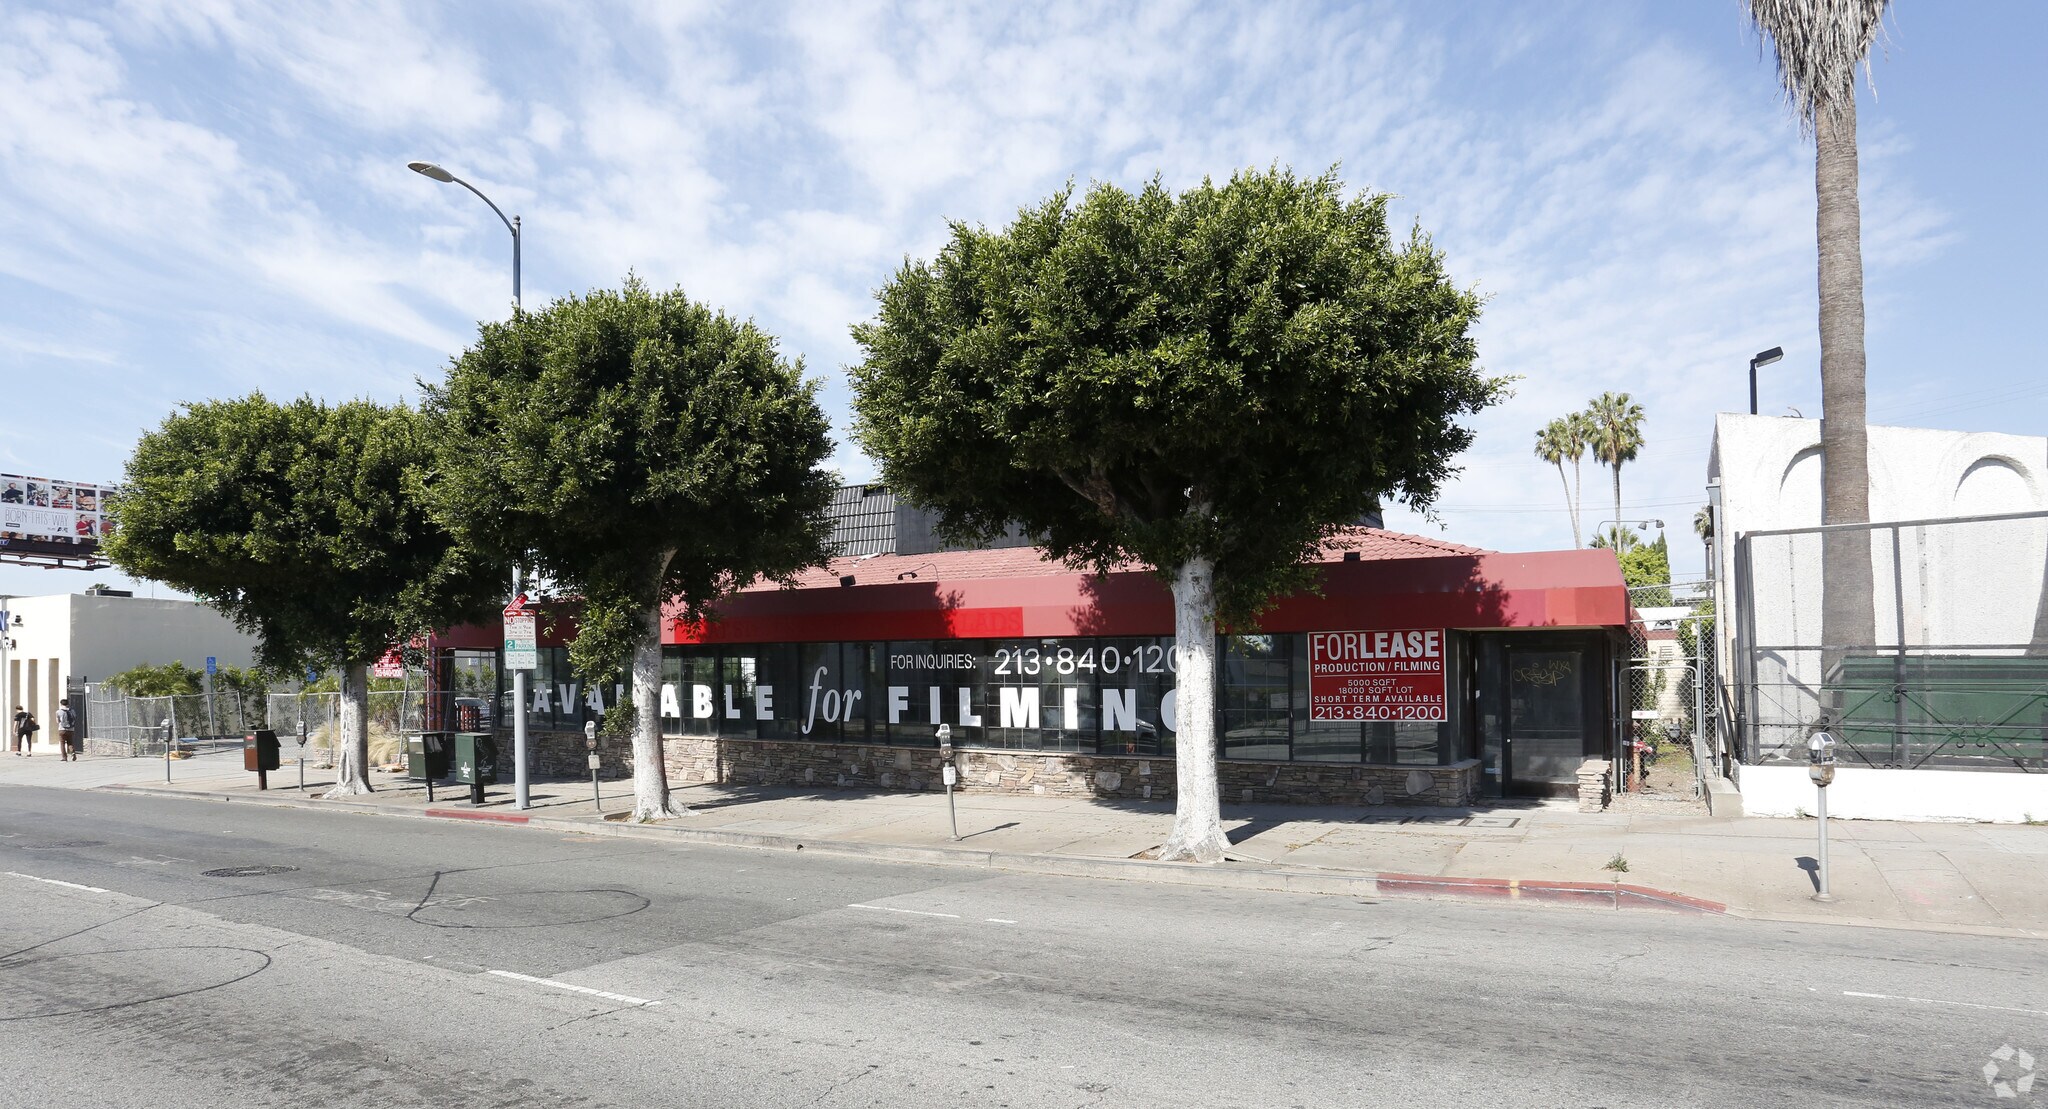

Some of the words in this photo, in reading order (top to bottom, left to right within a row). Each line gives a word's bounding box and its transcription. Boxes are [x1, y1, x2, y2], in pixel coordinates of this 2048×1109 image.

[5, 508, 28, 523] BORN
[31, 511, 49, 526] THIS
[52, 514, 69, 527] WAY
[890, 654, 914, 670] FOR
[916, 653, 977, 670] INQUIRIES:
[1314, 662, 1385, 673] PRODUCTION
[1394, 661, 1440, 672] FILMING
[1347, 679, 1370, 687] 5000
[1372, 678, 1397, 686] SQFT
[1368, 686, 1393, 694] SQFT
[1395, 686, 1413, 694] LOT
[532, 682, 774, 721] AVAABLE
[802, 666, 862, 735] for
[1314, 695, 1347, 703] SHORT
[1352, 695, 1380, 703] TERM
[1385, 694, 1442, 703] AVAILABLE
